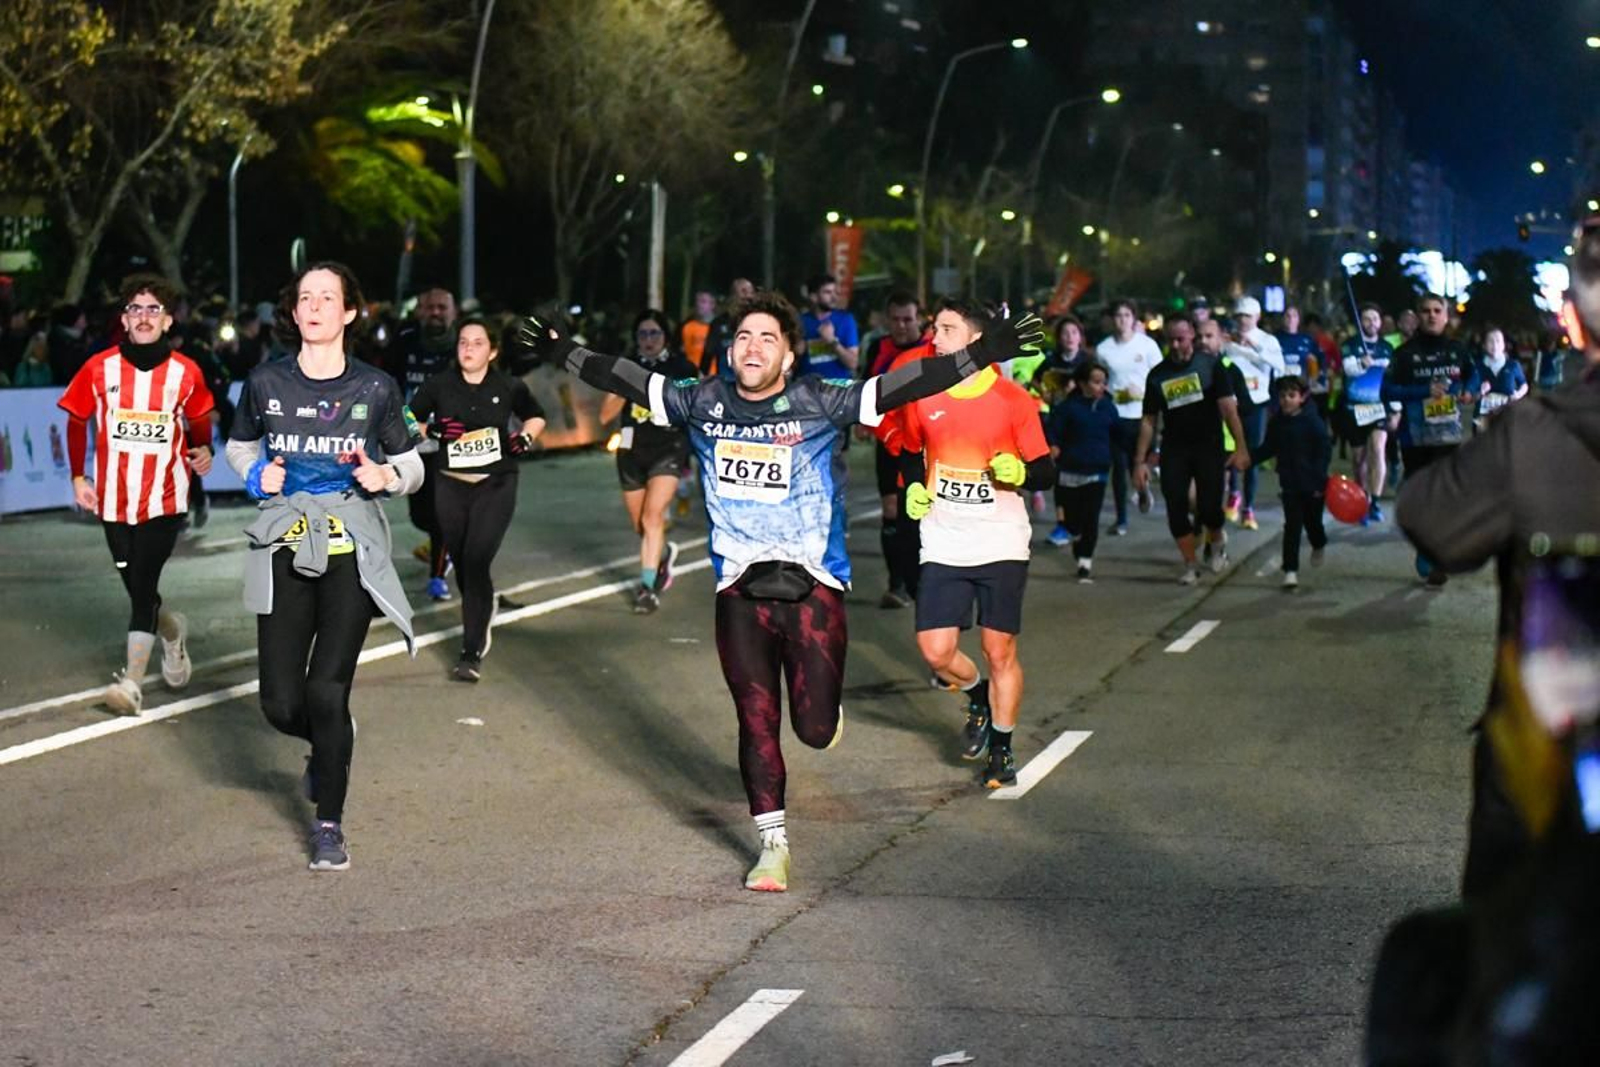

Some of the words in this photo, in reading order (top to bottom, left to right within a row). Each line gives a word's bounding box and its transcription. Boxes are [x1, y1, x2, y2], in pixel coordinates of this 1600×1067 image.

[117, 421, 166, 438] 6332
[702, 421, 737, 437] SAN
[268, 432, 300, 452] SAN
[304, 432, 366, 454] ANTÓN
[452, 436, 495, 454] 4589
[721, 457, 782, 481] 7678
[939, 478, 990, 498] 7576
